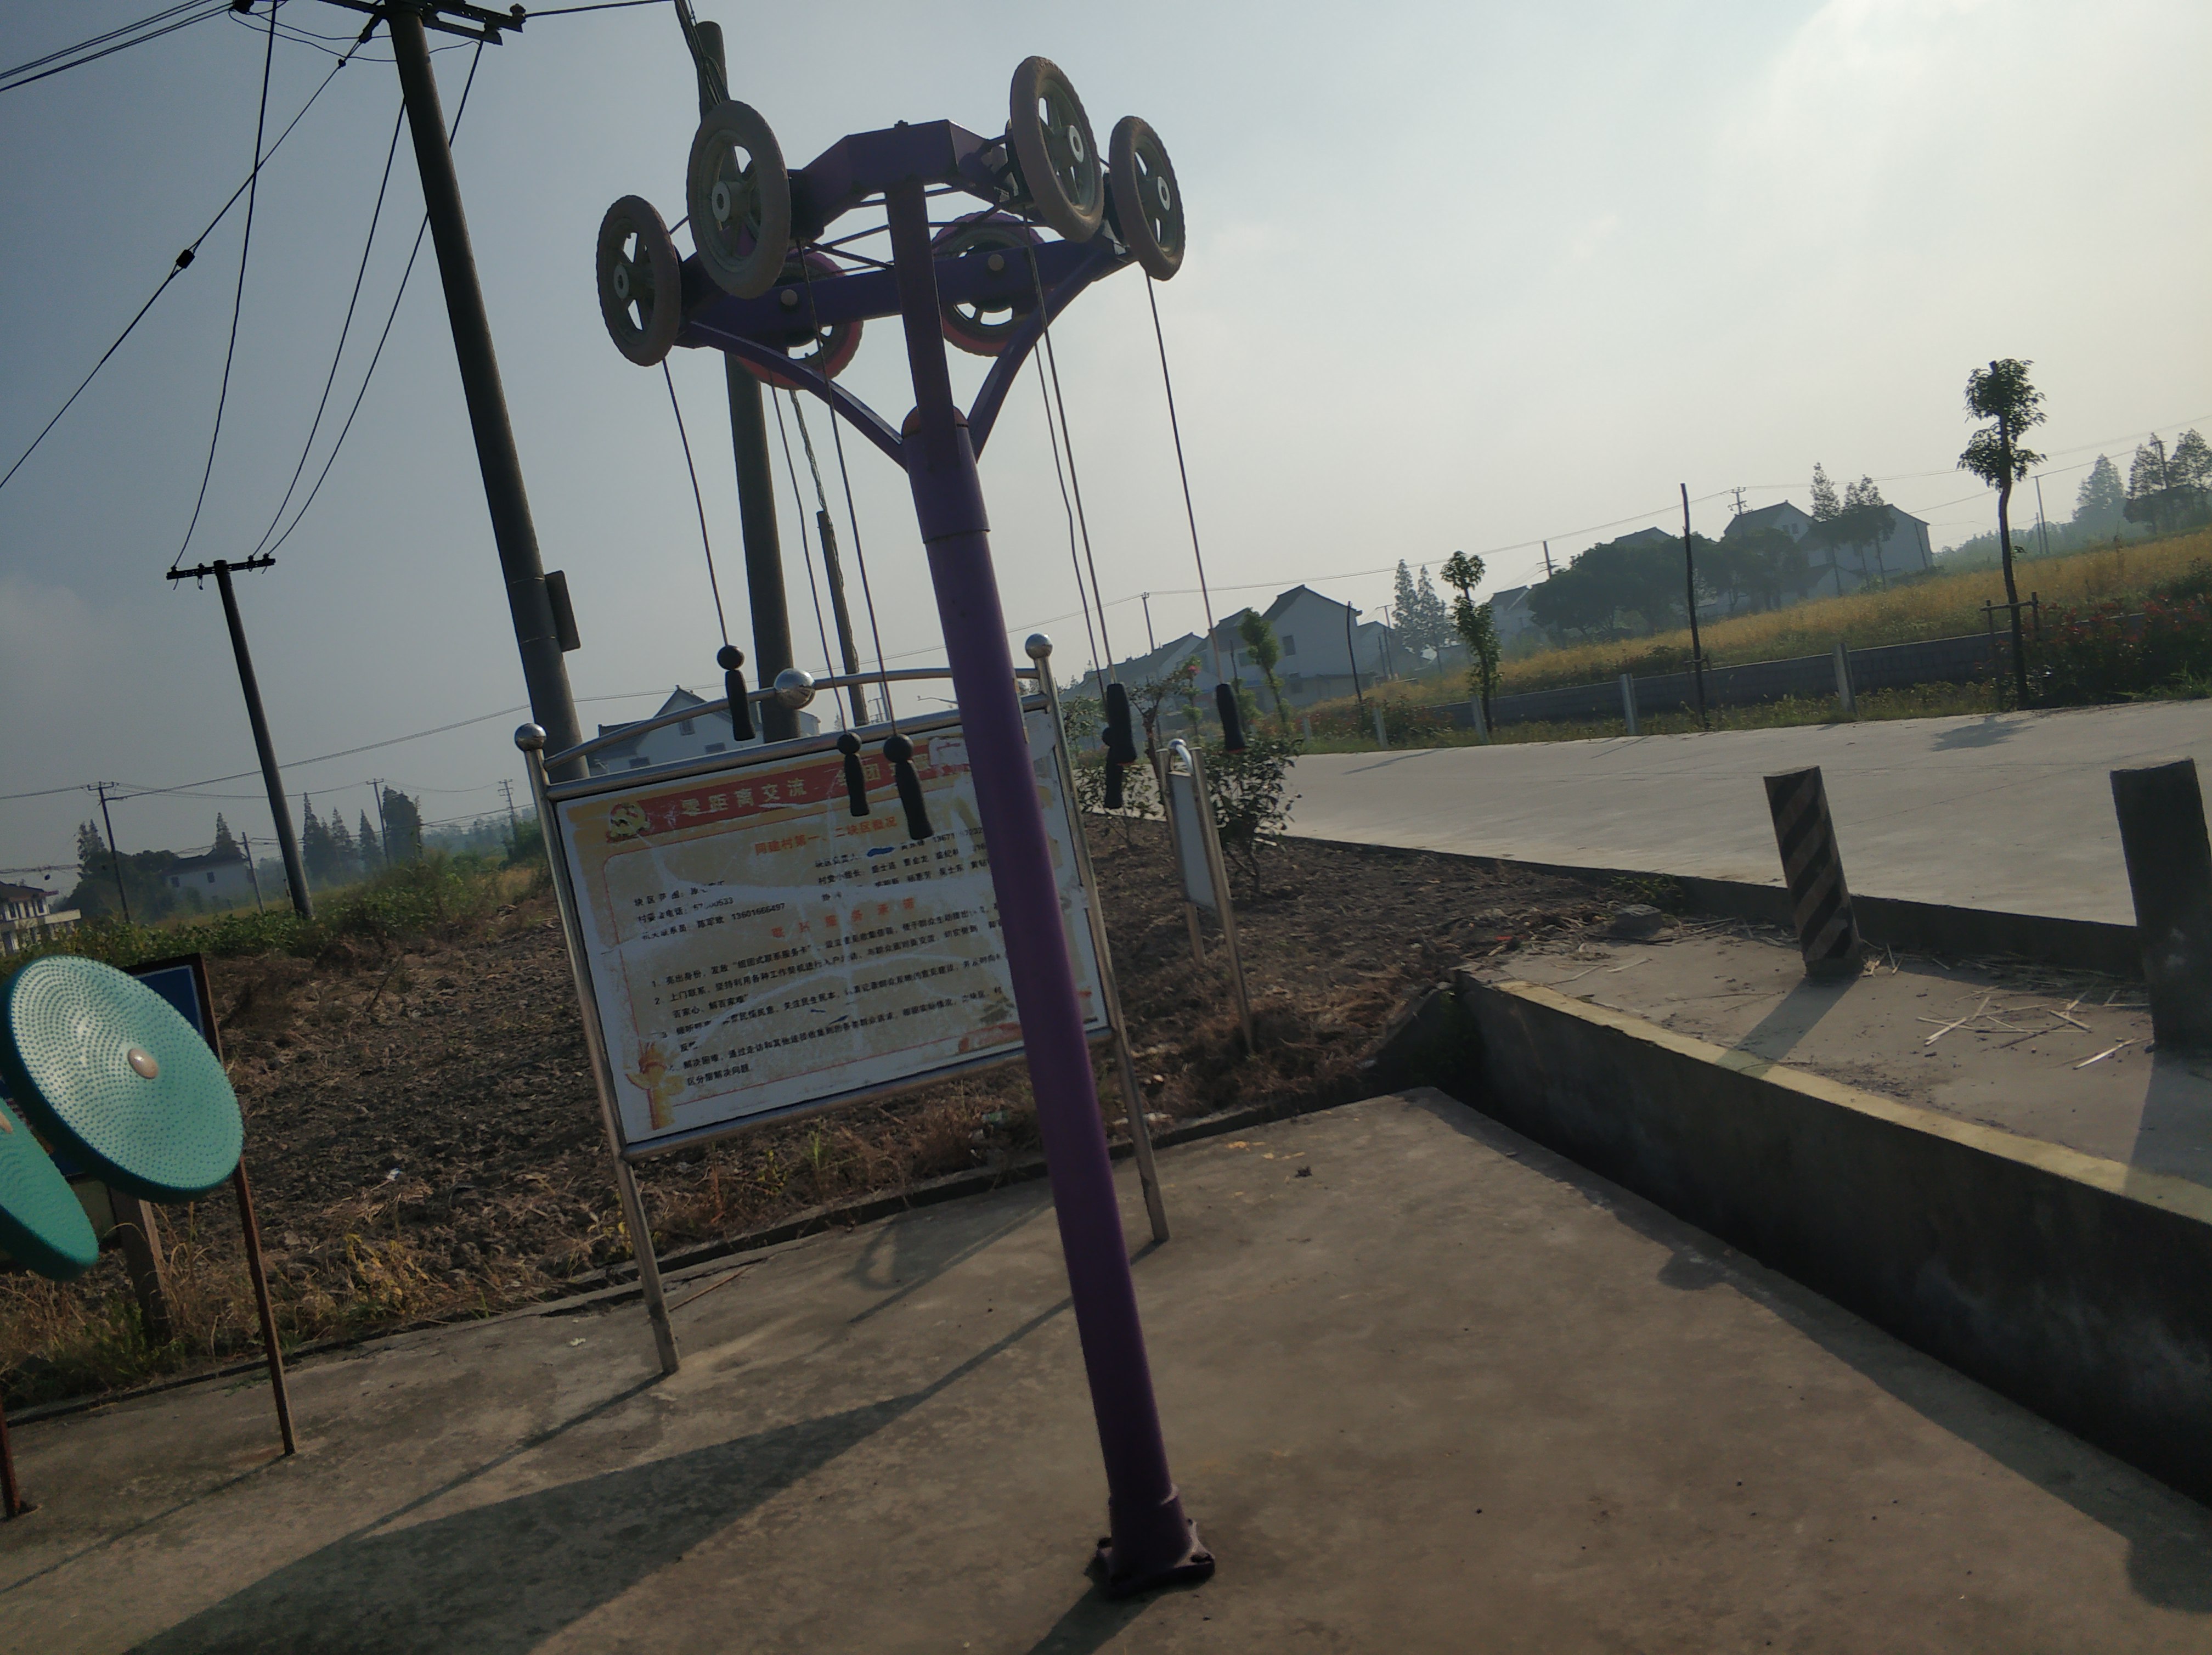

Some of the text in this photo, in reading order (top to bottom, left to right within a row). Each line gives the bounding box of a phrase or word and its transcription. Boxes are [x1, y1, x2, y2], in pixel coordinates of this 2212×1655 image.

[679, 776, 807, 819] 零距离交流
